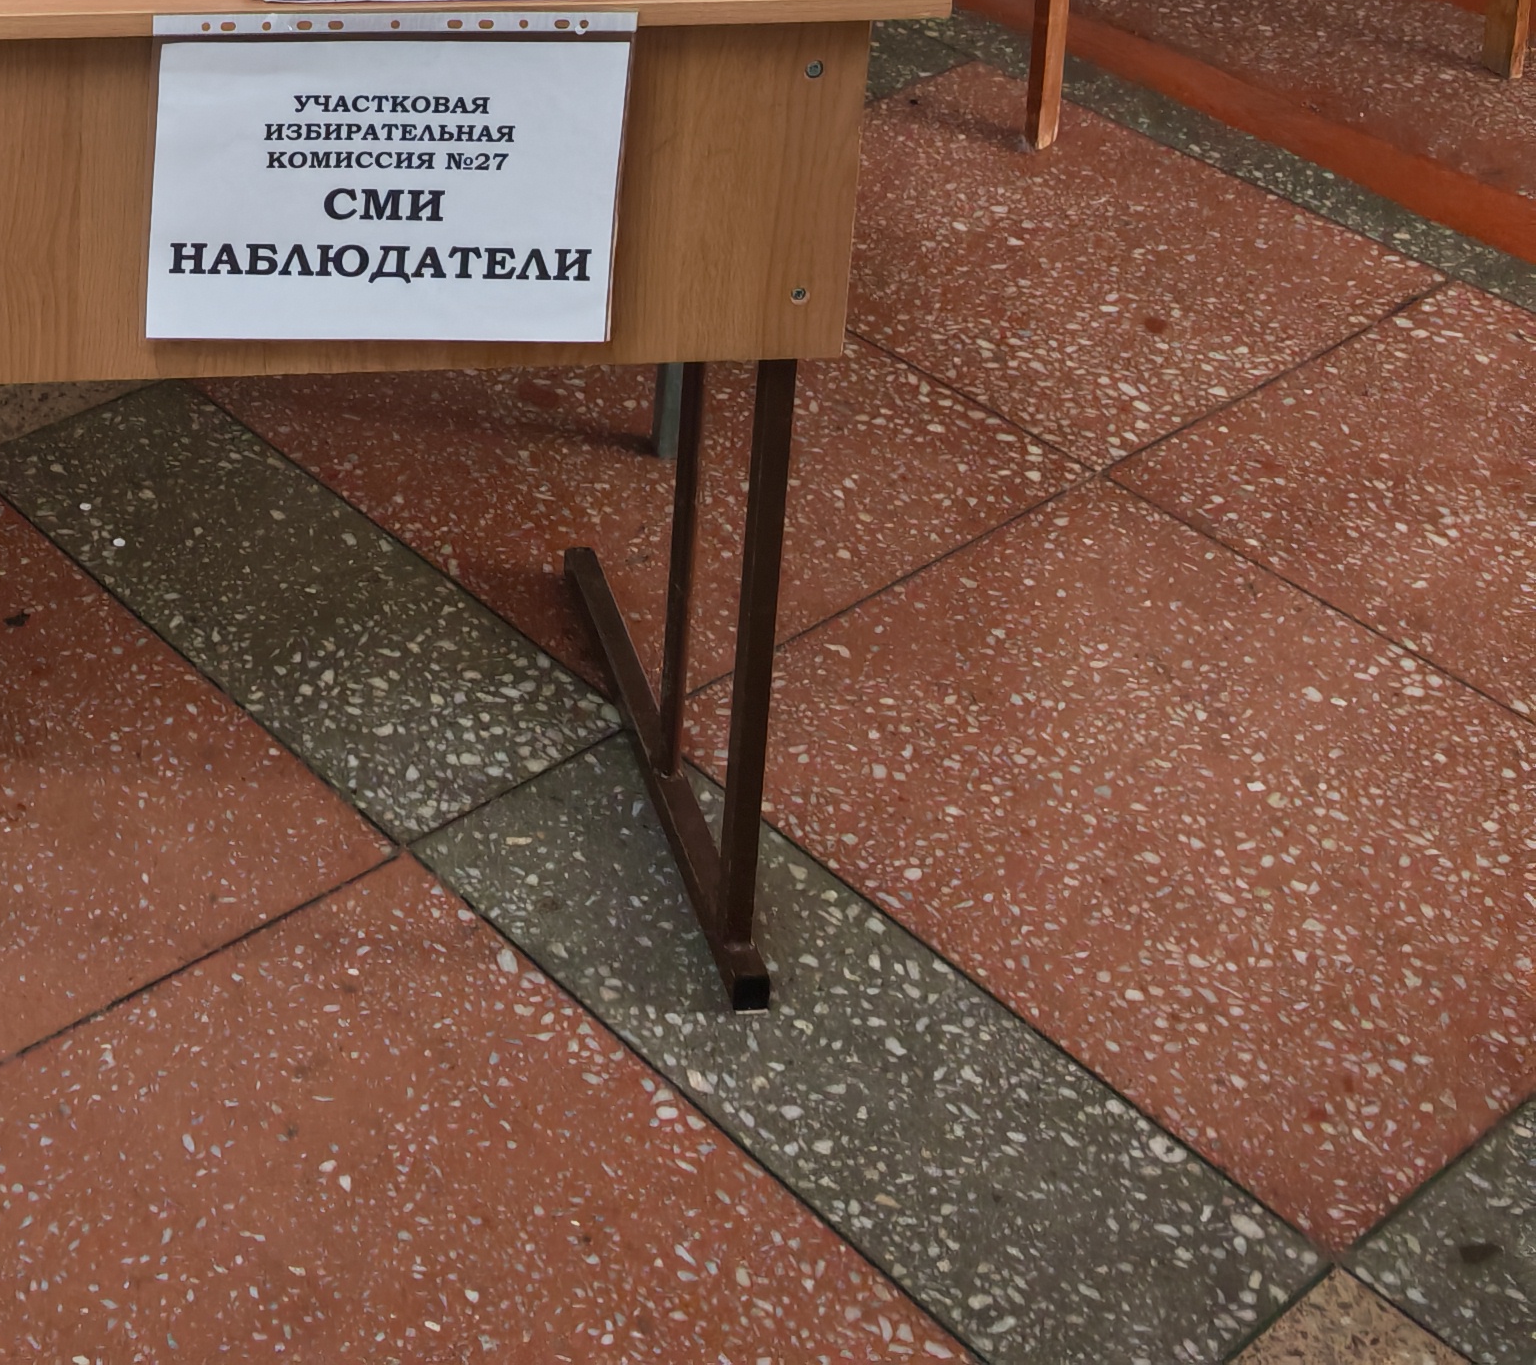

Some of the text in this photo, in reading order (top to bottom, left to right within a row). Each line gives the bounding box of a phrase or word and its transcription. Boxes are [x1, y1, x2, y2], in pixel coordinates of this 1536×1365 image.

[293, 94, 490, 115] УЧАСТКОВАЯ
[264, 123, 516, 144] ИЗБИРАТЕЛЬНАЯ
[265, 151, 510, 172] КОМИССИЯ №27
[323, 188, 446, 222] СМИ
[168, 242, 593, 284] НАБЛЮДАТЕЛИ
